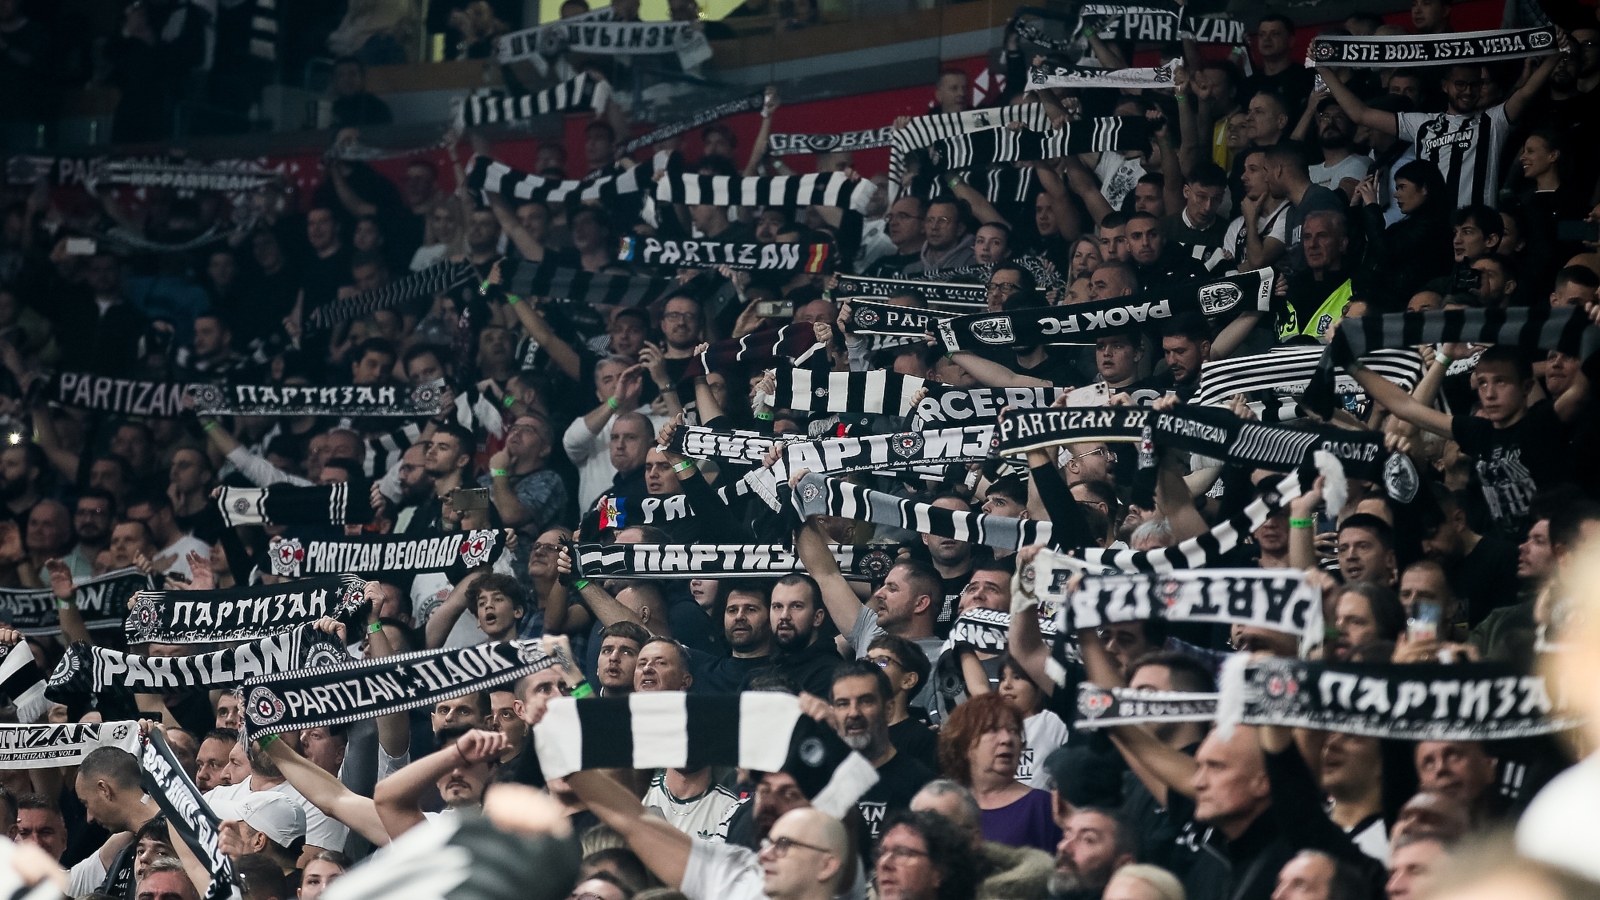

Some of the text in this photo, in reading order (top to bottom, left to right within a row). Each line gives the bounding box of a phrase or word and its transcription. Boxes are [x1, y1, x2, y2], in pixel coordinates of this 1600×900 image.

[1342, 35, 1526, 61] ISTE BOJE, ISTA VERA
[643, 237, 800, 270] PARTIZAN
[1038, 299, 1173, 335] PAOK FC
[59, 372, 189, 417] PARTIZAN
[235, 384, 397, 406] ПАРТИЗАН
[1000, 409, 1116, 442] PARTIZAN
[1156, 413, 1174, 432] FK
[1174, 416, 1228, 444] PARTIZAN
[1360, 442, 1379, 463] FC
[305, 541, 382, 573] PARTIZAN
[382, 533, 464, 571] BEOGRAD
[633, 544, 854, 572] ПАРТИЗН
[170, 588, 328, 629] ПАРТИЗАН
[100, 632, 291, 688] PARTIZAN
[283, 671, 405, 718] PARTIZAN
[1317, 669, 1555, 723] ПАРТИЗА
[12, 751, 47, 760] PARTIZAN
[48, 750, 57, 758] SE
[58, 749, 76, 757] VOLI
